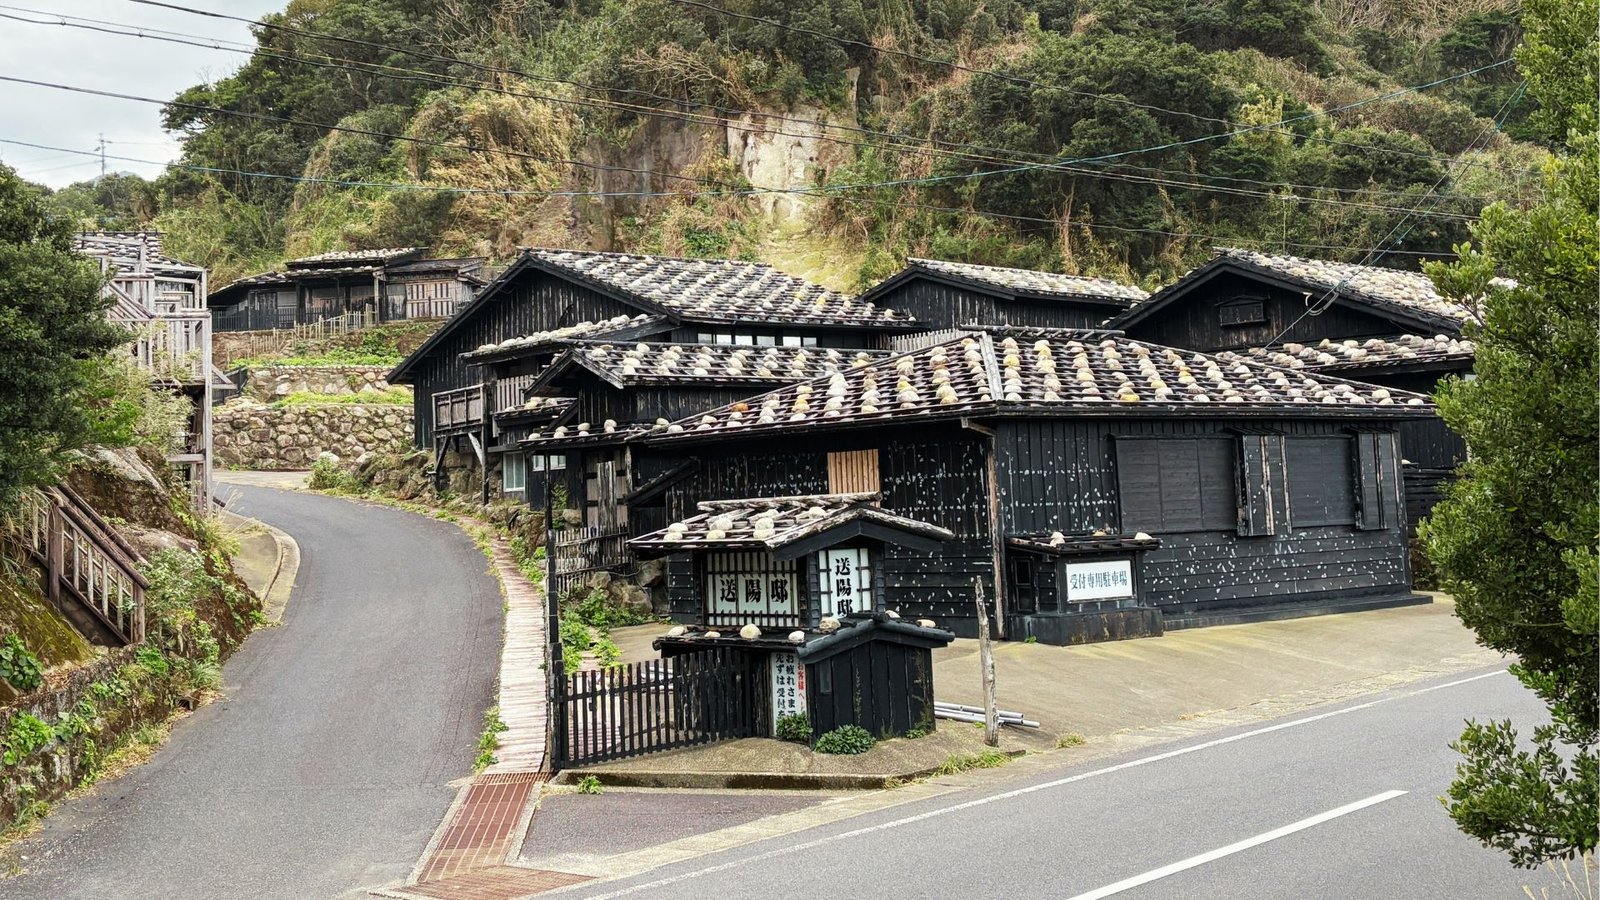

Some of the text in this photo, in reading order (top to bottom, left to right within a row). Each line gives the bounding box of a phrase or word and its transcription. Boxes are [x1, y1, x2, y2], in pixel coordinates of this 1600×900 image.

[720, 578, 788, 603] 送陽邸
[835, 558, 853, 618] 送陽邸
[1070, 570, 1128, 590] 受付専用駐車場
